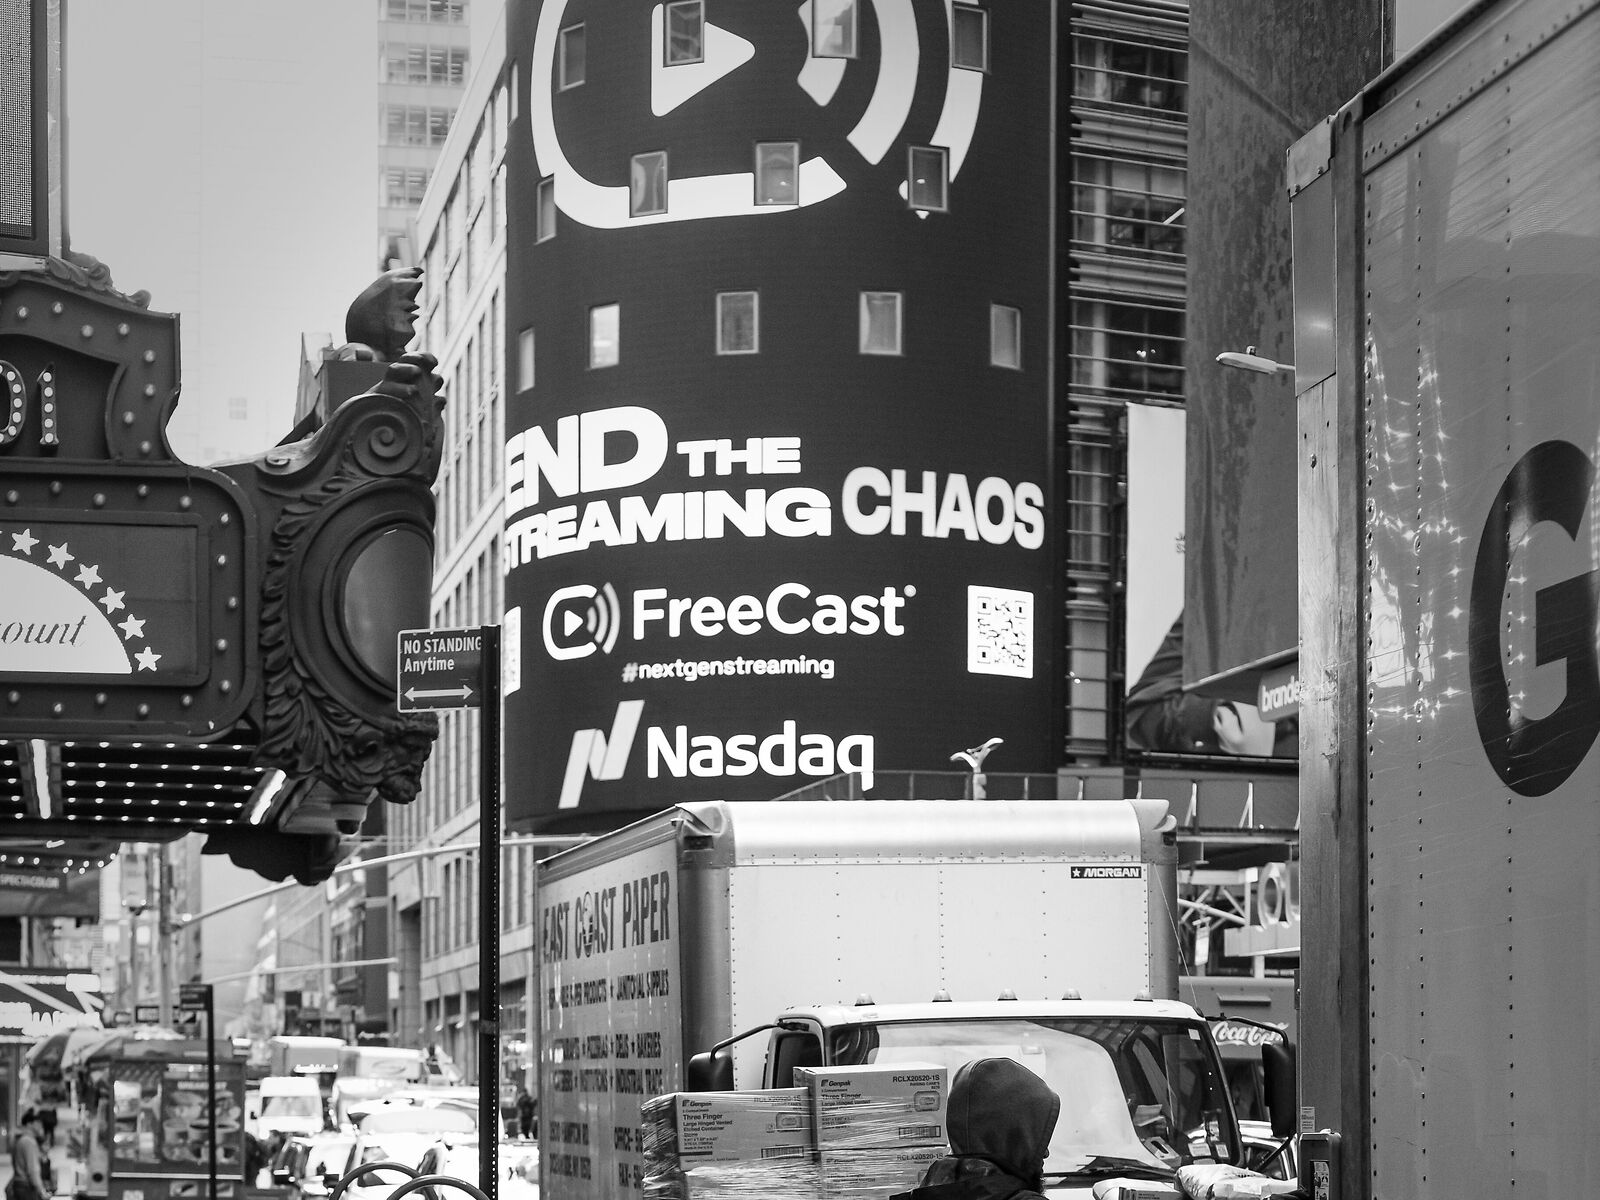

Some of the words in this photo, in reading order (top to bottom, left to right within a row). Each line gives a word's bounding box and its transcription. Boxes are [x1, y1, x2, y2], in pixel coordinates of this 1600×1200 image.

[505, 405, 668, 520] END
[677, 437, 802, 478] THE
[842, 466, 1045, 550] CHAOS
[634, 583, 905, 642] FreeCast
[0, 615, 87, 645] ount
[404, 639, 421, 655] NO
[424, 636, 482, 653] STANDING
[404, 657, 456, 675] Anytime
[621, 655, 835, 683] #nextgenstreaming
[647, 720, 875, 792] Nasdaq
[1083, 867, 1140, 878] MORGAN
[543, 902, 570, 963] EAST
[575, 887, 617, 957] COAST
[622, 870, 670, 949] PAPER
[892, 1075, 940, 1083] RCLX20520-1S
[702, 1113, 723, 1121] Finger
